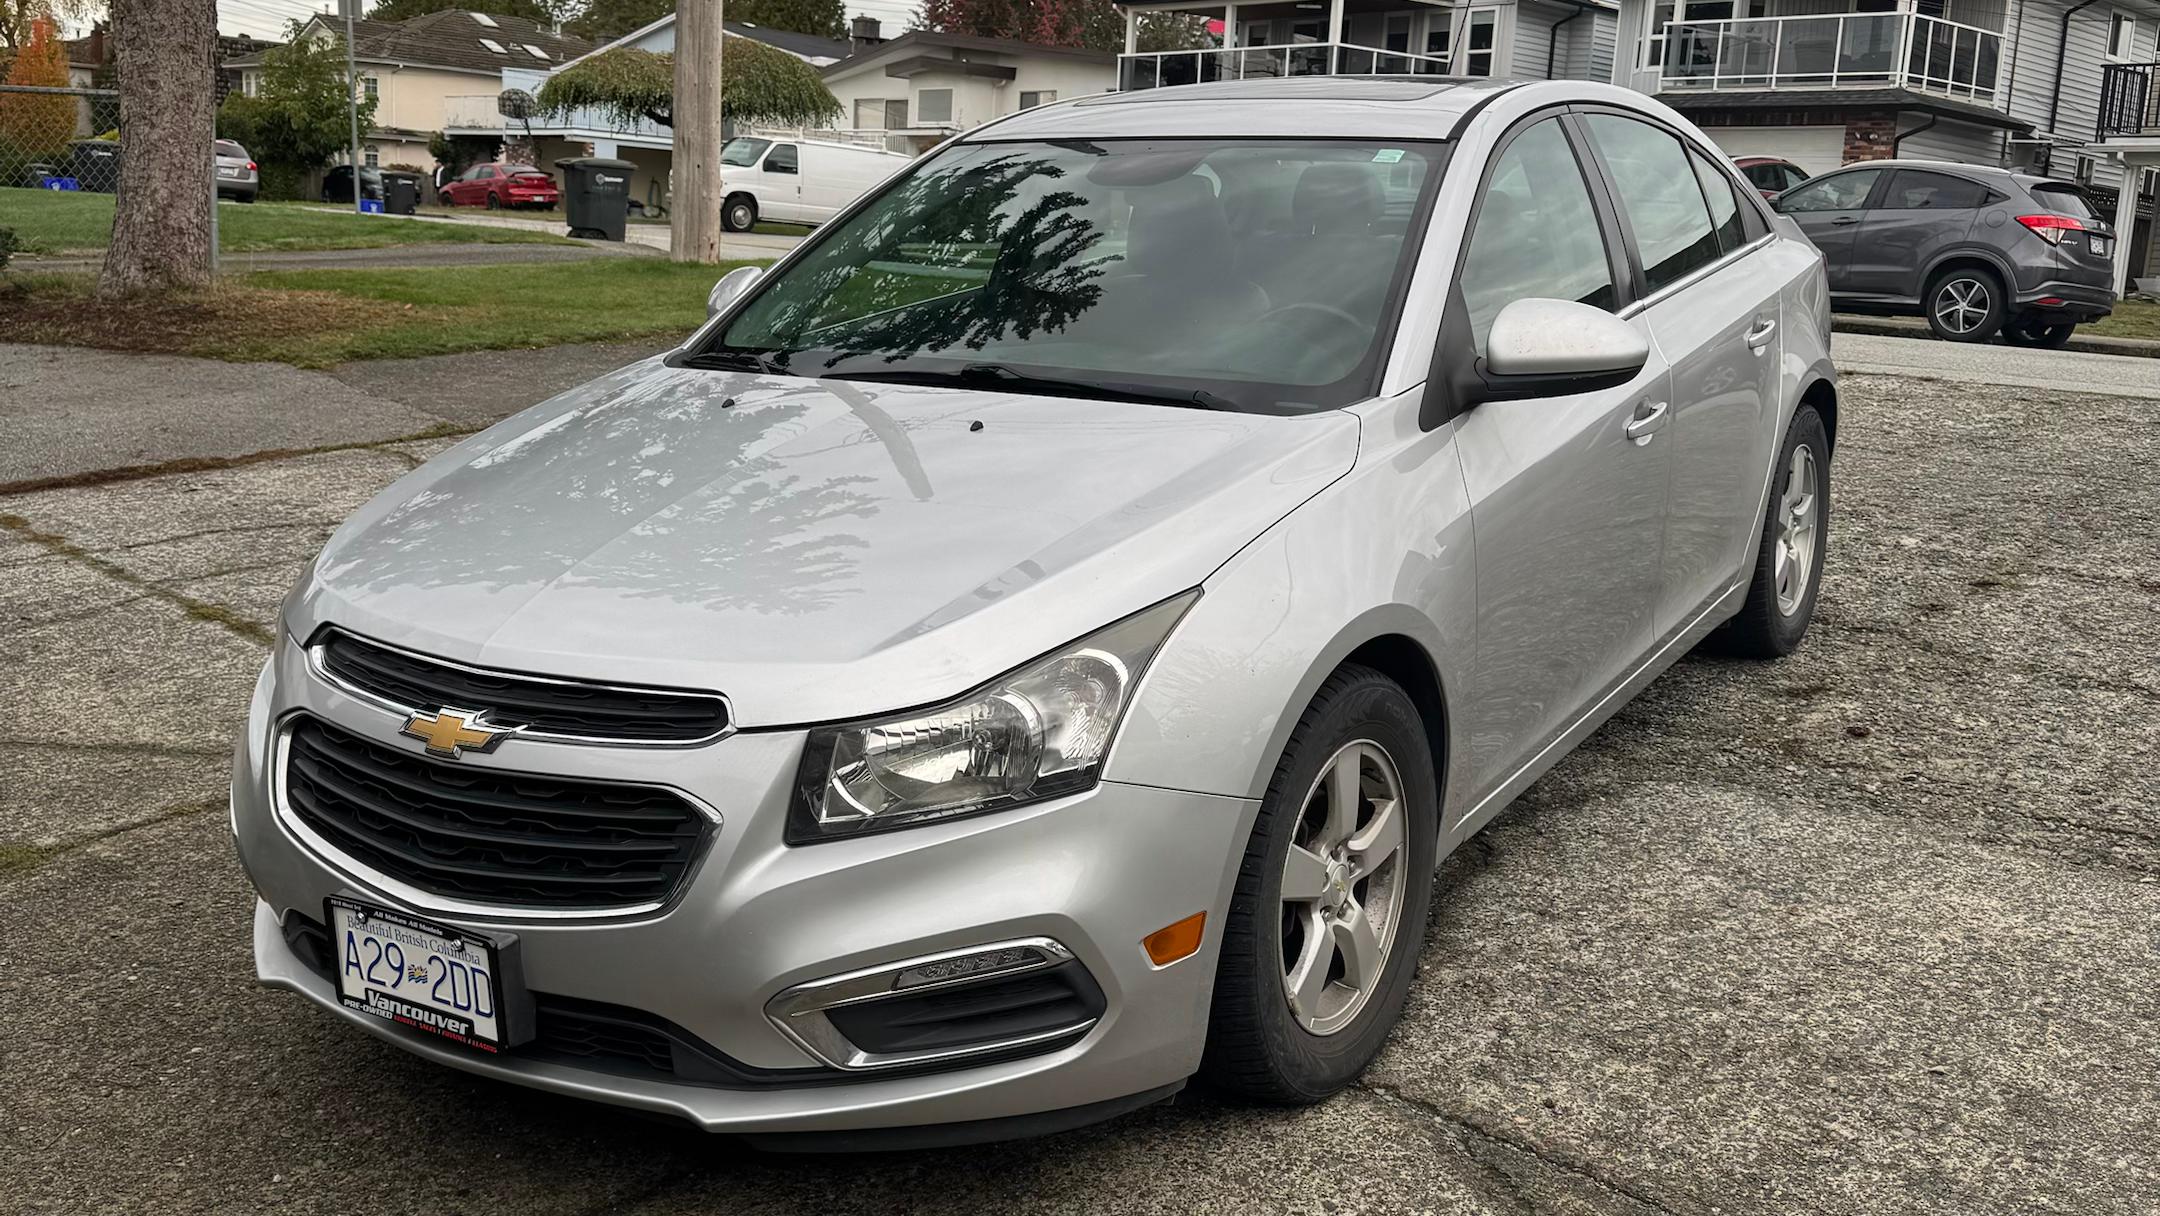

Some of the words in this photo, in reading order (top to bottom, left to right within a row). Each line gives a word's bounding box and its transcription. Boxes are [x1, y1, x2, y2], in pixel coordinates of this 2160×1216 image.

[347, 915, 393, 939] Beautiful
[395, 928, 428, 950] British
[430, 940, 481, 965] Columbia
[373, 911, 384, 919] All
[408, 920, 418, 928] All
[345, 930, 405, 989] A29
[428, 955, 494, 1018] 2DD
[344, 999, 393, 1019] PRE-OWNED
[367, 990, 469, 1035] Vancouver
